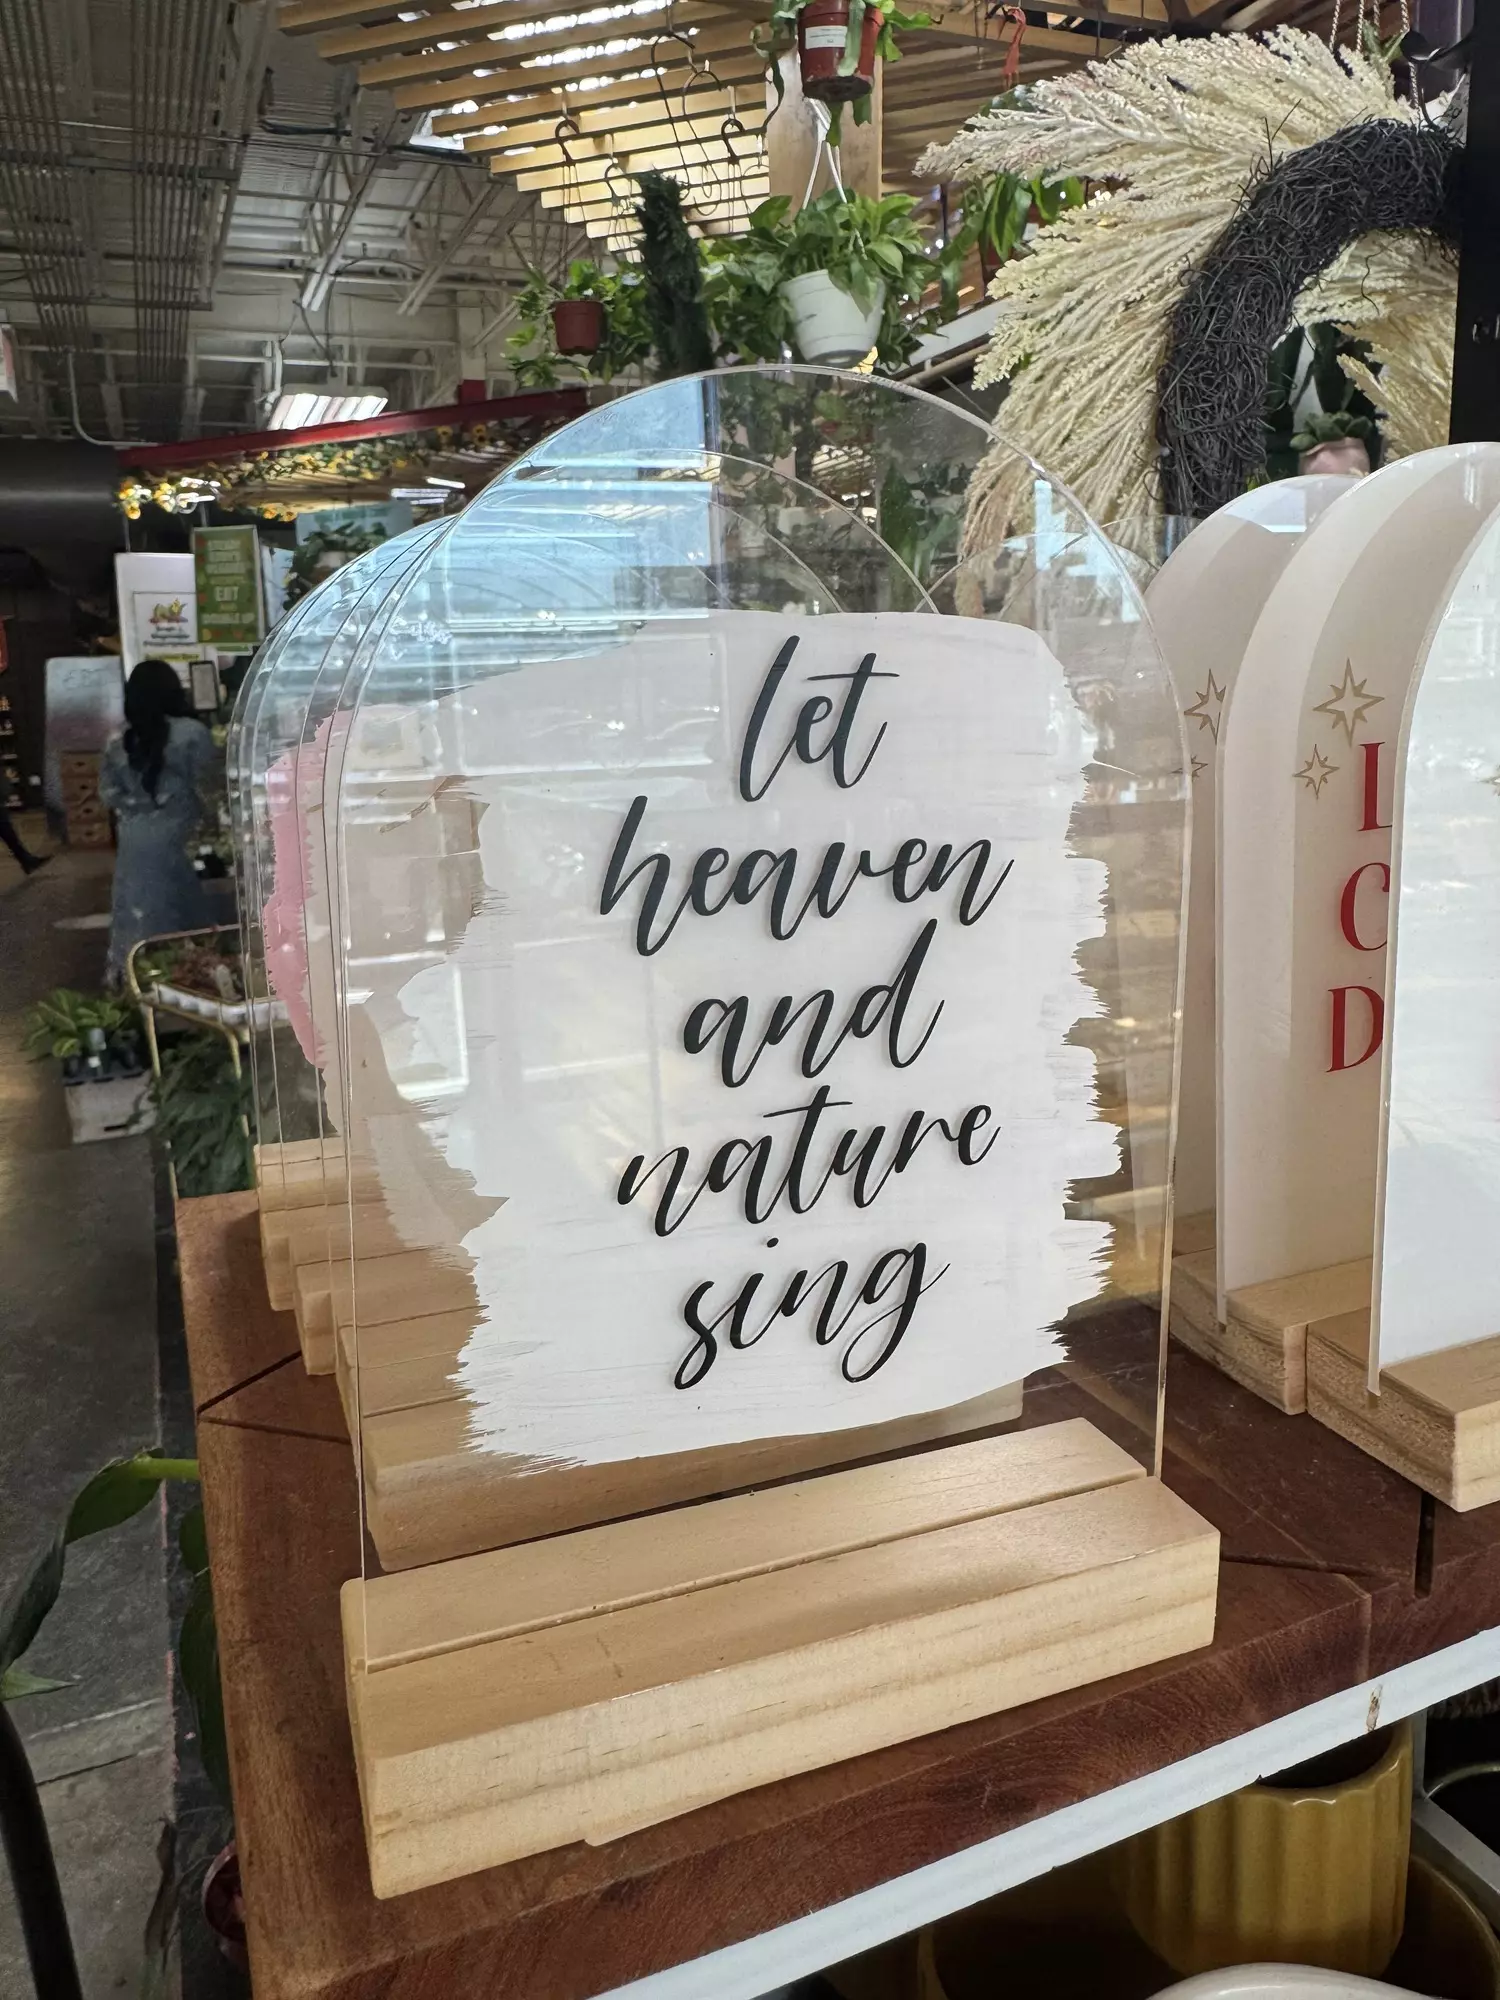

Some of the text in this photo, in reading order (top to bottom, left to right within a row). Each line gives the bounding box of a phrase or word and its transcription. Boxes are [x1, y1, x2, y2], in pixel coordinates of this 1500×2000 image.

[739, 635, 900, 802] let
[599, 795, 1015, 957] heaven
[683, 918, 945, 1088] and
[616, 1085, 1001, 1237] nature
[673, 1237, 951, 1390] sing
